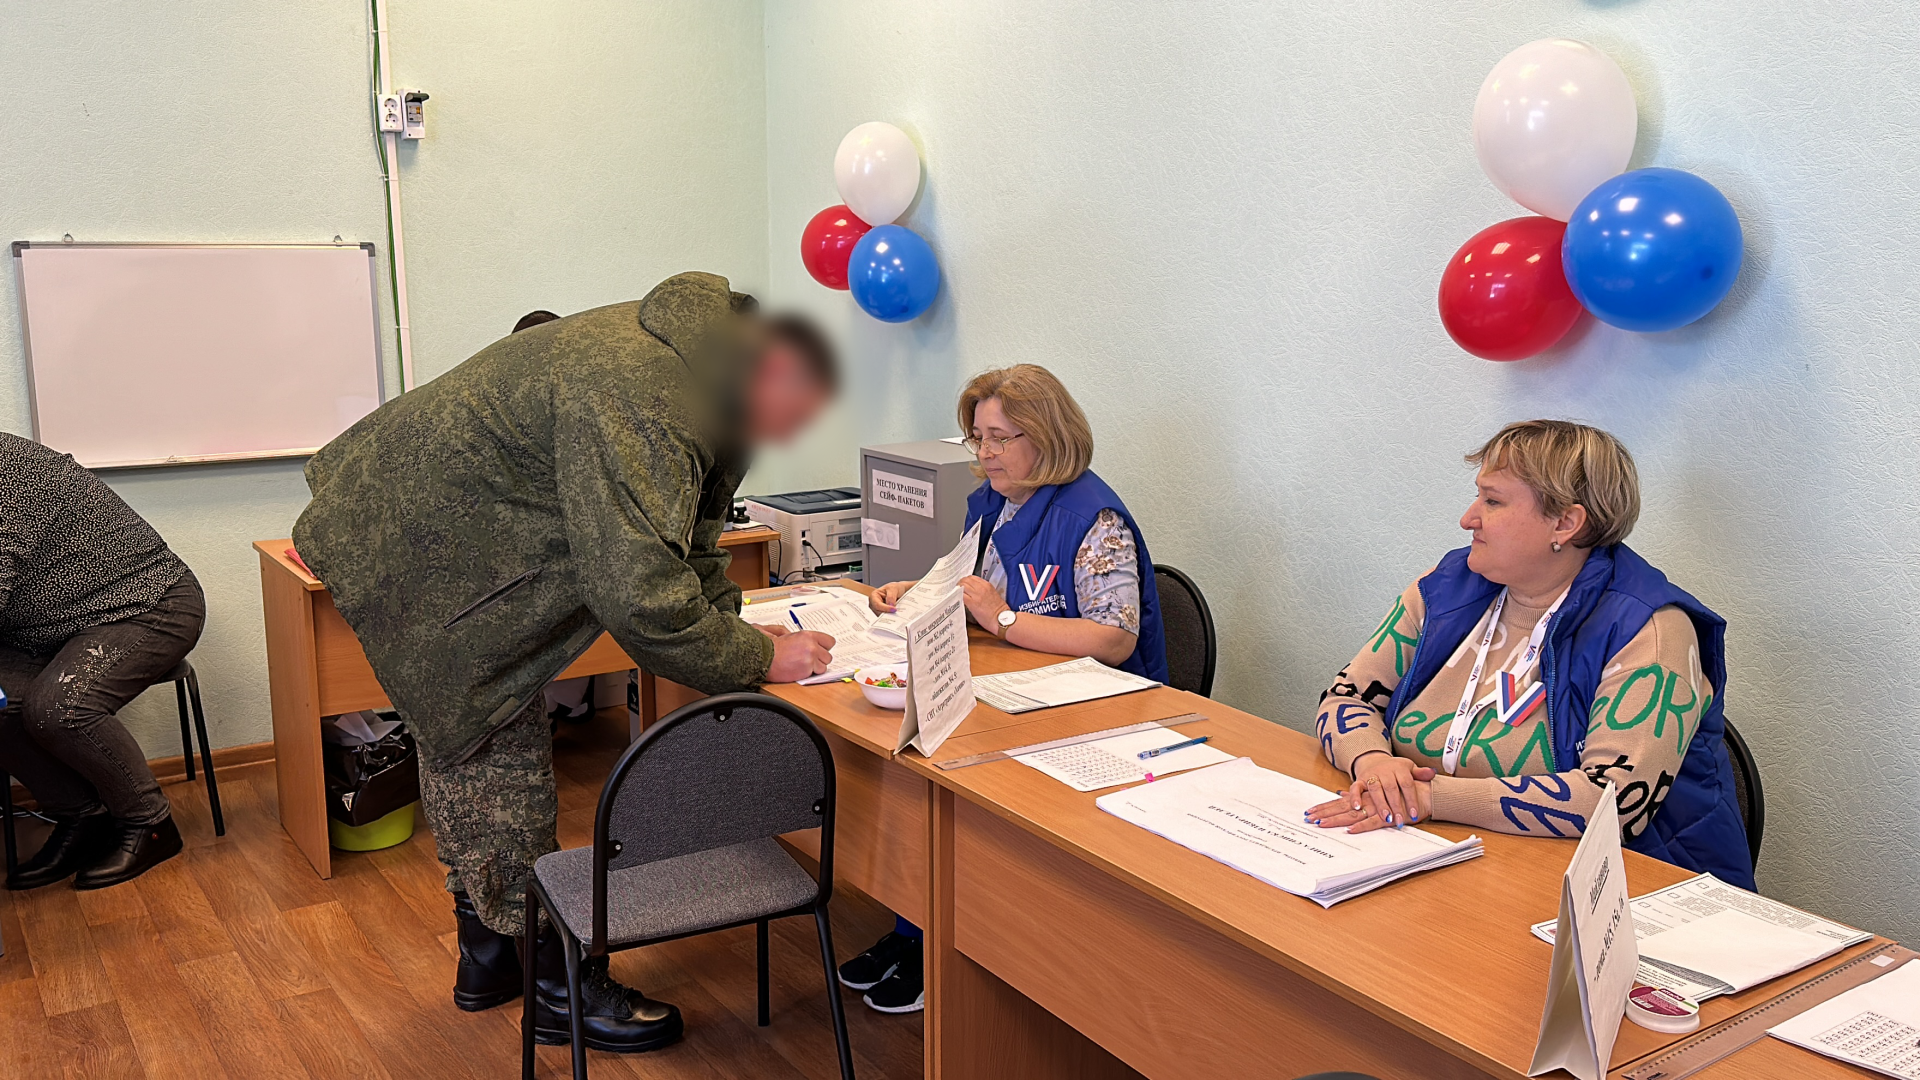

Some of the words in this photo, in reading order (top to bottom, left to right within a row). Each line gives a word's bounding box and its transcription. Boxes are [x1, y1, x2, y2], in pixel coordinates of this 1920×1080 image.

[876, 479, 896, 490] МЕСТО
[897, 483, 927, 497] ХРАНЕНИЯ
[898, 495, 924, 508] ПАКЕТОВ
